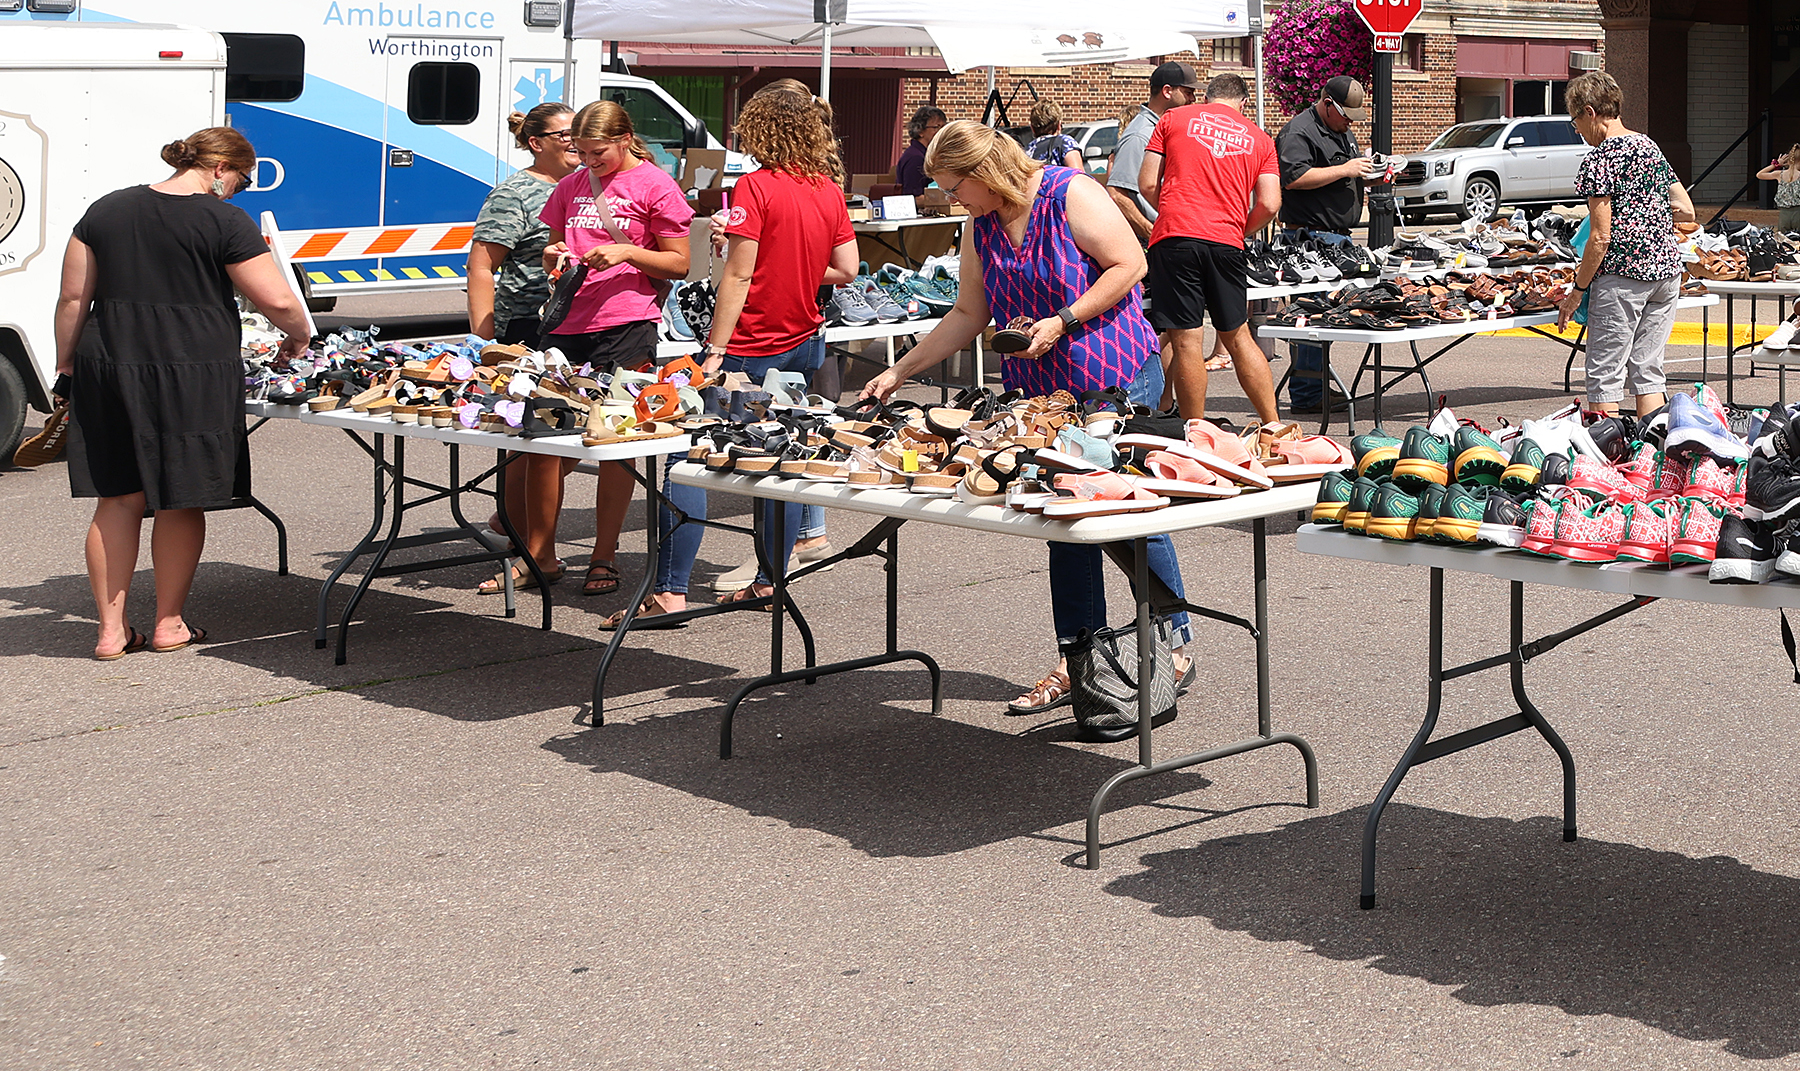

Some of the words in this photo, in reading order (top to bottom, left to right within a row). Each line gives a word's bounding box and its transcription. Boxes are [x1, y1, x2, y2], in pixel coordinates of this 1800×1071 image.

[323, 1, 495, 29] Ambulance
[368, 38, 493, 61] Worthington
[1377, 37, 1400, 49] 4-WAY
[1193, 123, 1213, 135] FIT
[1214, 130, 1250, 148] NIGHT
[565, 216, 631, 230] STRENTH
